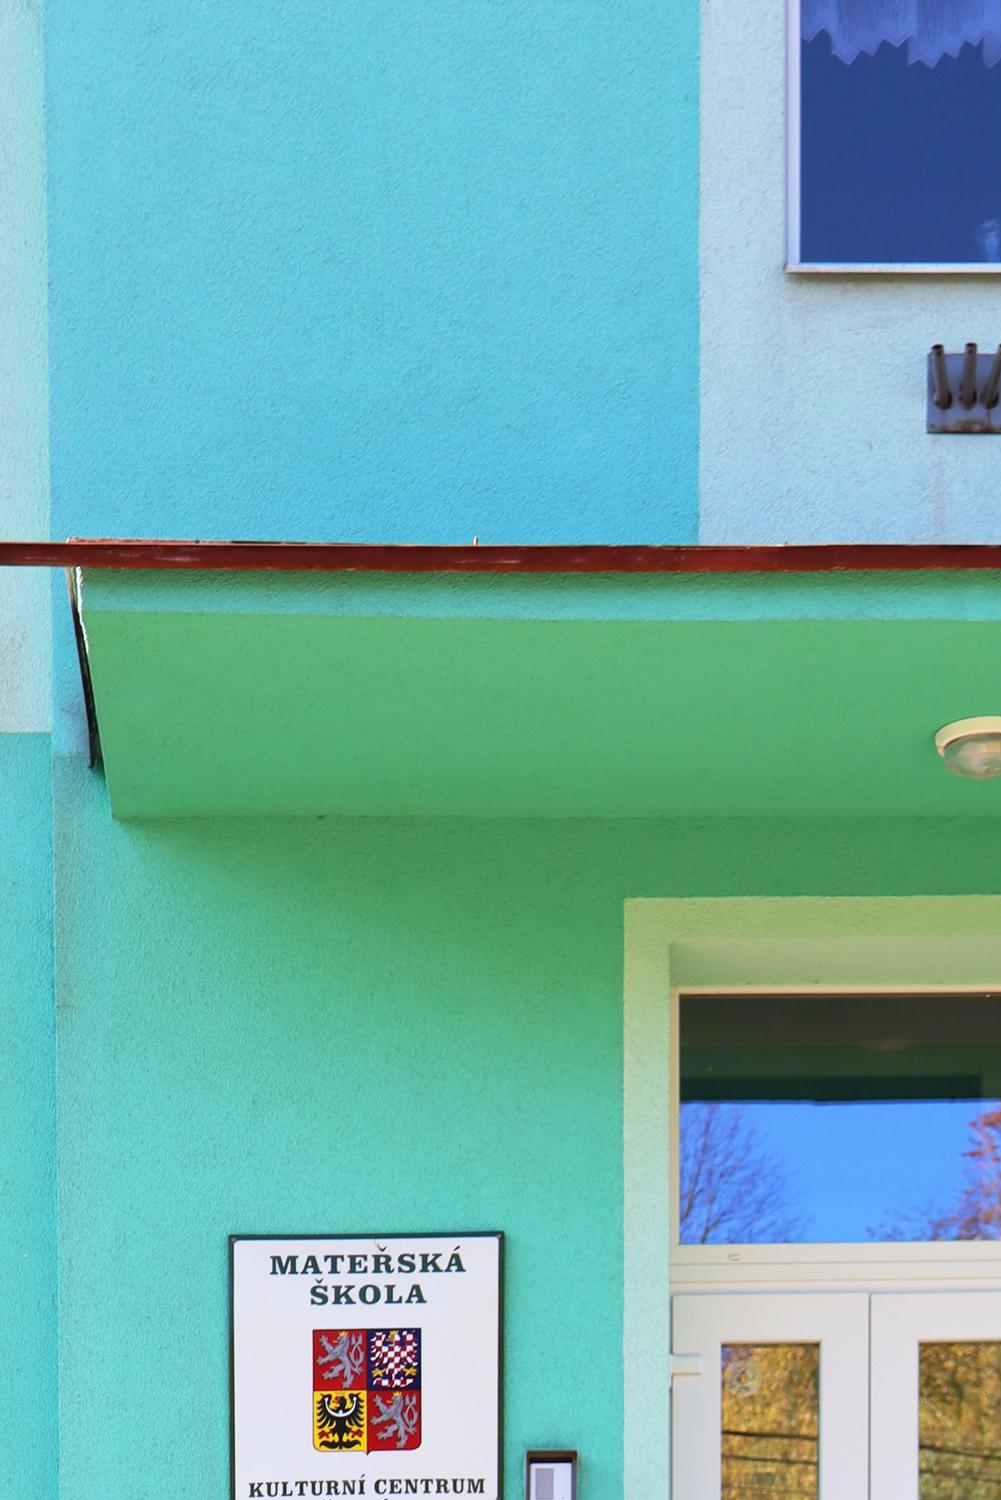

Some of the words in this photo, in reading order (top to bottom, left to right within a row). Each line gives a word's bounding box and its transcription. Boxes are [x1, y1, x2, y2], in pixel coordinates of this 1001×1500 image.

[270, 1246, 467, 1275] MATEŘSKÁ
[310, 1278, 427, 1306] ŠKOLA
[248, 1474, 367, 1498] KULTURNÍ
[373, 1478, 485, 1495] CENTRUM
